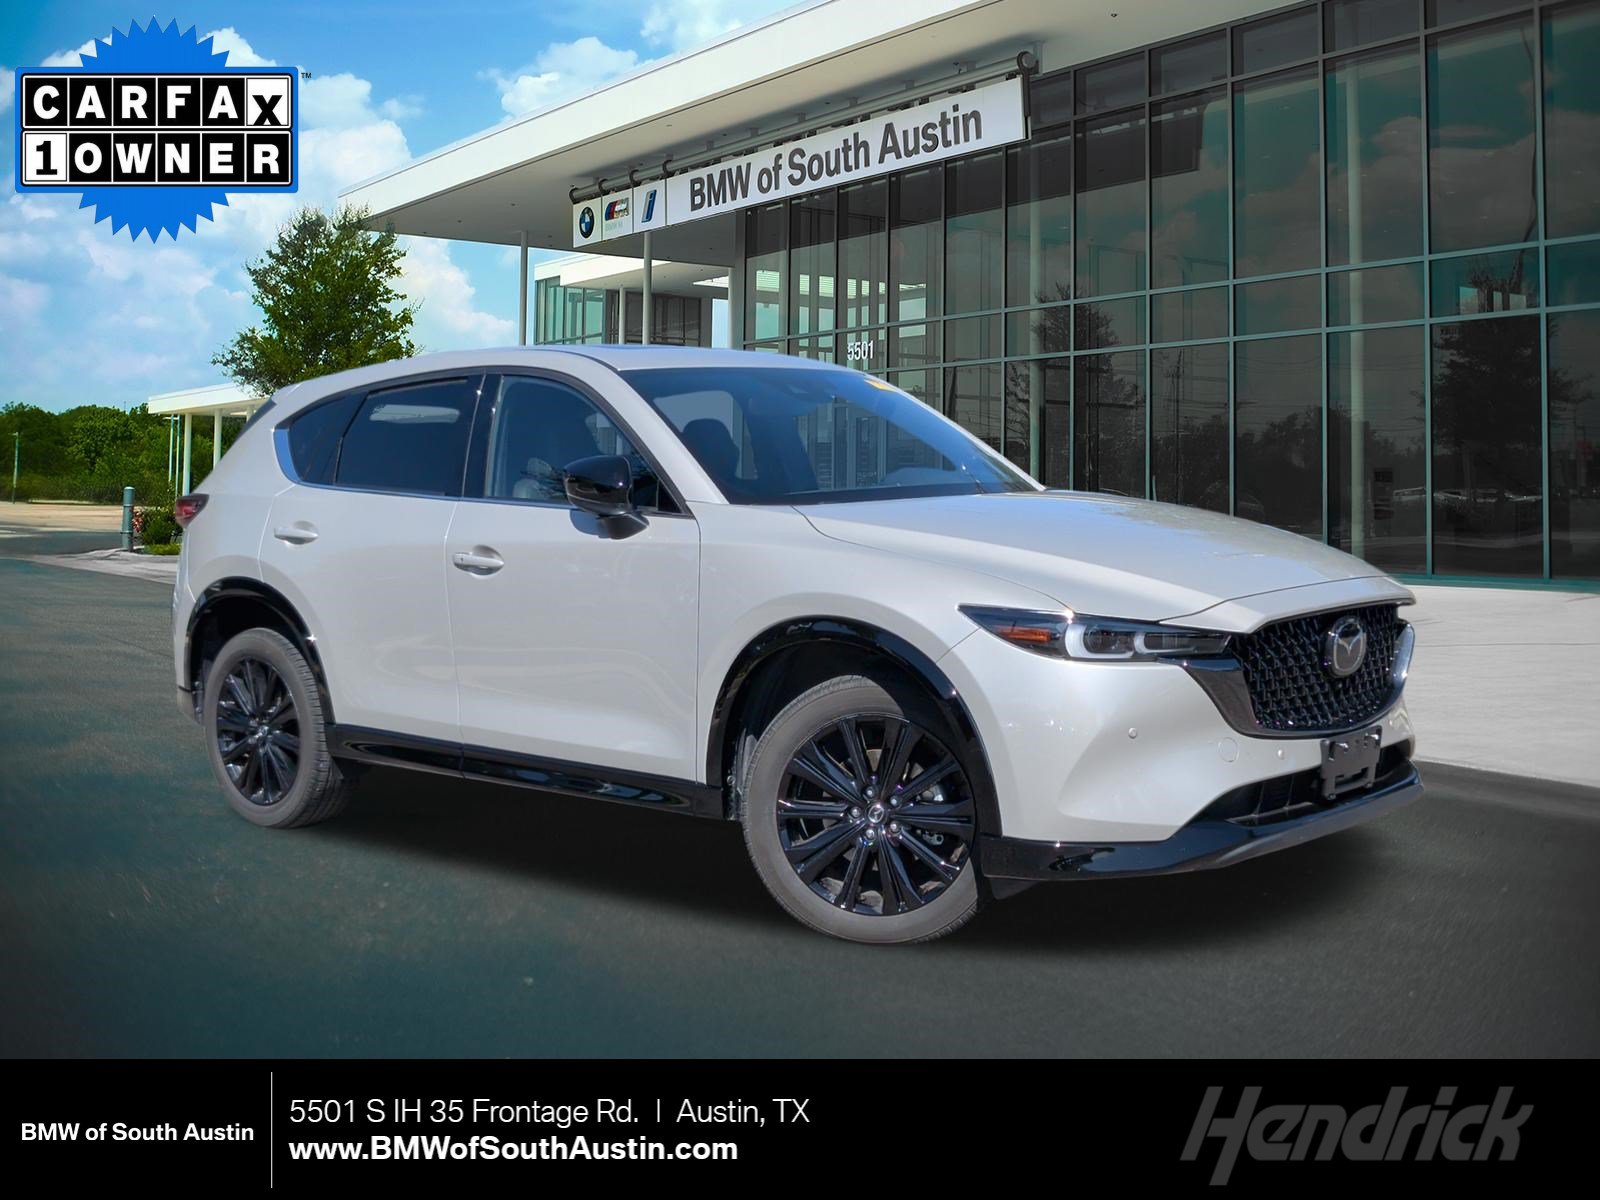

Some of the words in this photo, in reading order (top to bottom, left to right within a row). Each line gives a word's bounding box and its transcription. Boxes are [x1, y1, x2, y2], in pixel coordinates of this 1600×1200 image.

[689, 162, 752, 212] BMW
[757, 153, 783, 194] of
[787, 132, 870, 186] South
[878, 103, 982, 164] Austin
[847, 340, 874, 360] 5501
